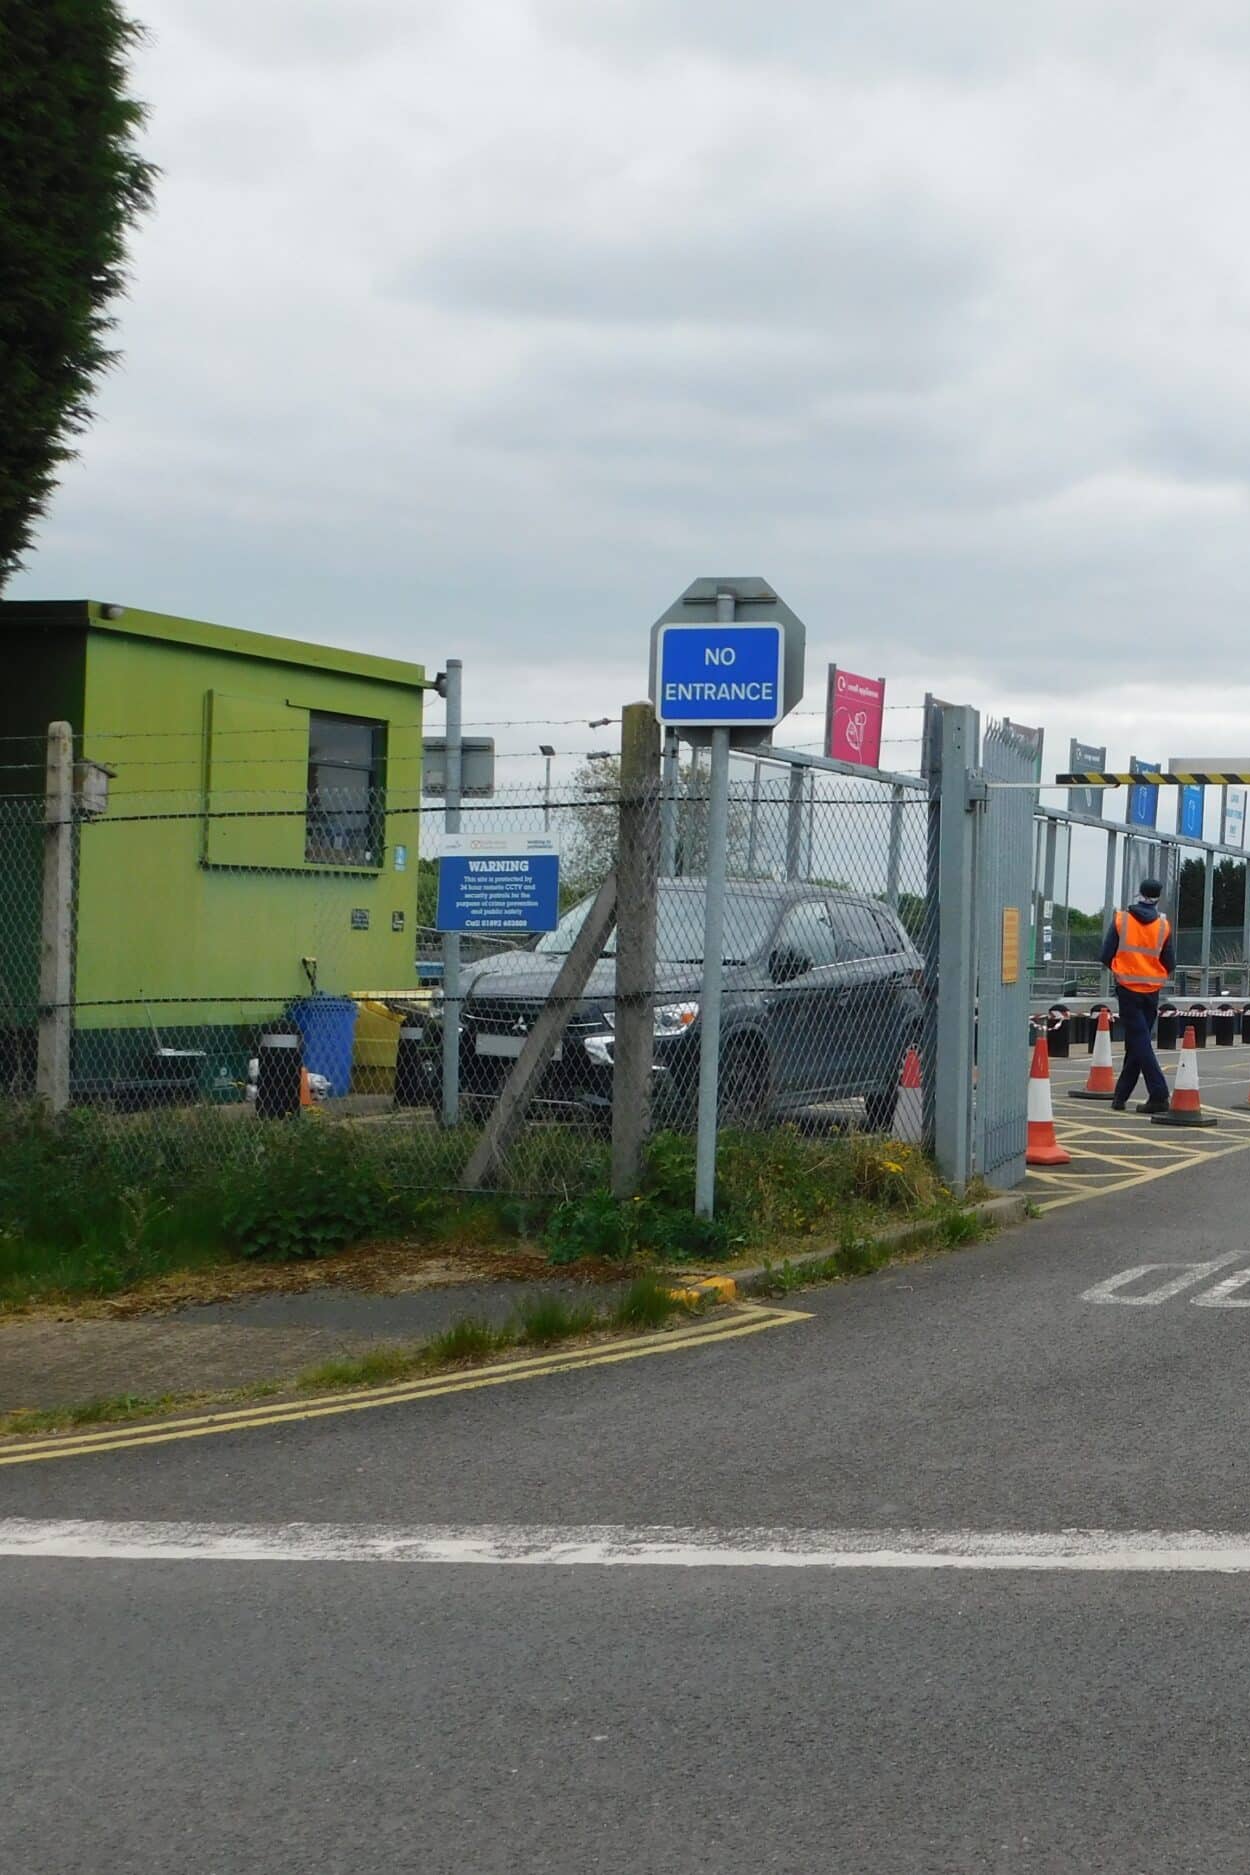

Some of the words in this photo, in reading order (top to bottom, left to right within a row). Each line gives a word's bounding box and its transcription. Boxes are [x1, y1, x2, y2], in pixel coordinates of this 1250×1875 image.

[704, 647, 736, 666] NO
[665, 682, 773, 701] ENTRANCE
[468, 861, 529, 872] WARNING
[495, 876, 523, 884] protected
[524, 876, 533, 884] by
[464, 892, 488, 900] security
[488, 892, 510, 900] patrols
[483, 909, 503, 917] public
[504, 909, 523, 917] safety
